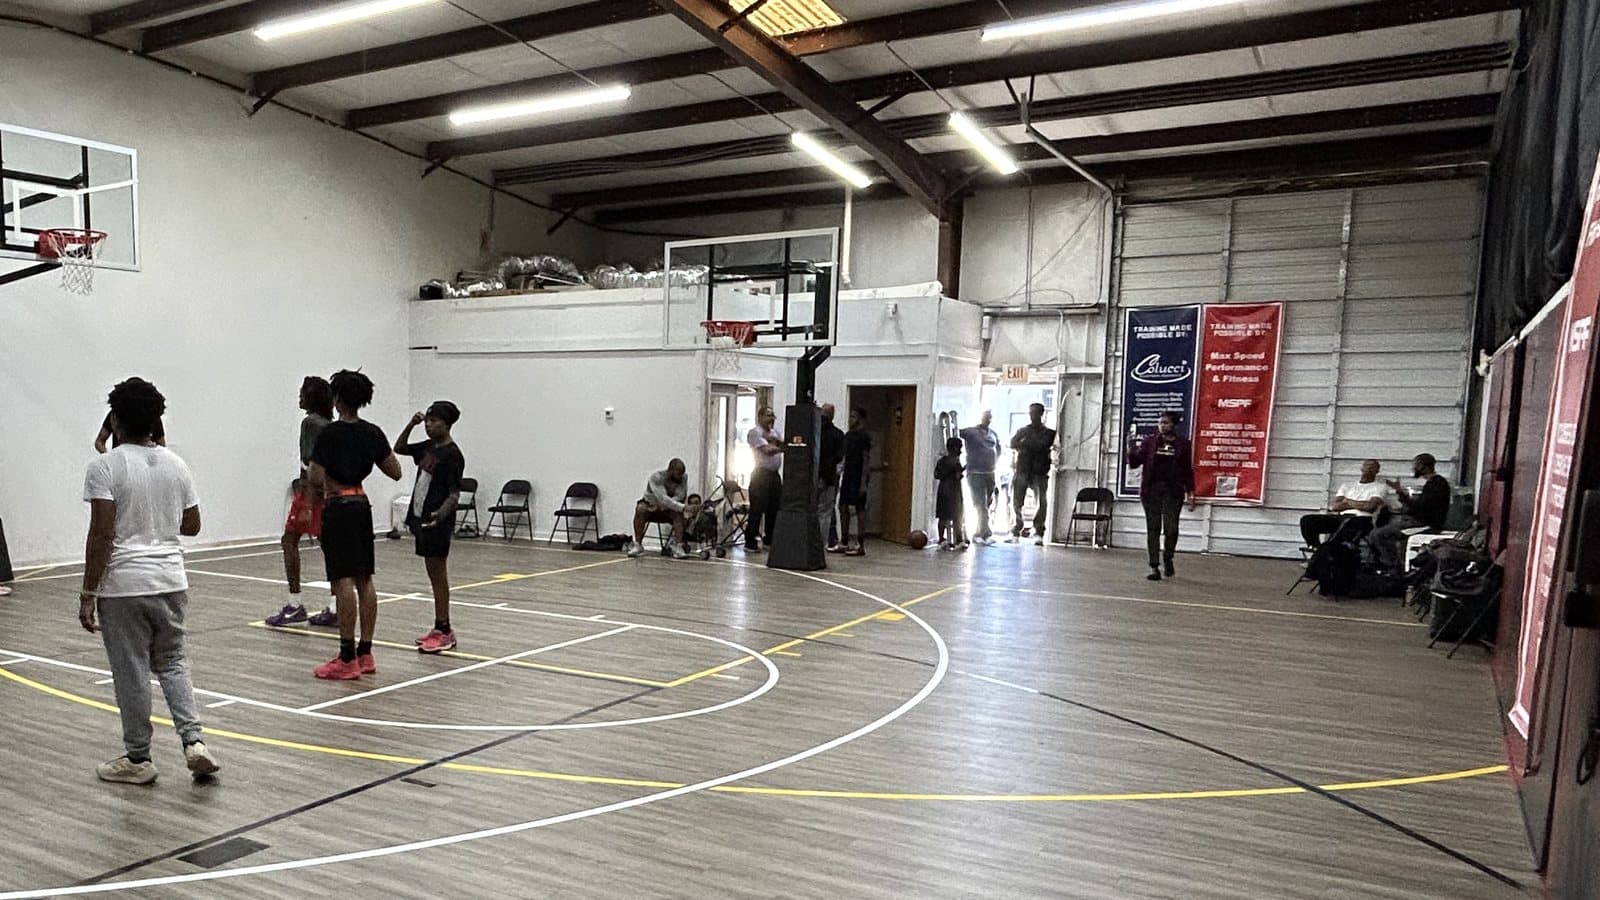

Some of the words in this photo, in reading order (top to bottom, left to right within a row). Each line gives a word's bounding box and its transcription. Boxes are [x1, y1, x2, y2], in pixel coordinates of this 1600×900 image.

[1134, 325, 1168, 333] TRAINING
[1210, 352, 1231, 360] Max
[1233, 352, 1265, 361] Speed
[1135, 353, 1188, 375] Colucci
[1205, 363, 1269, 371] Performance
[1007, 367, 1024, 379] EXIT
[1217, 399, 1253, 408] MSPF
